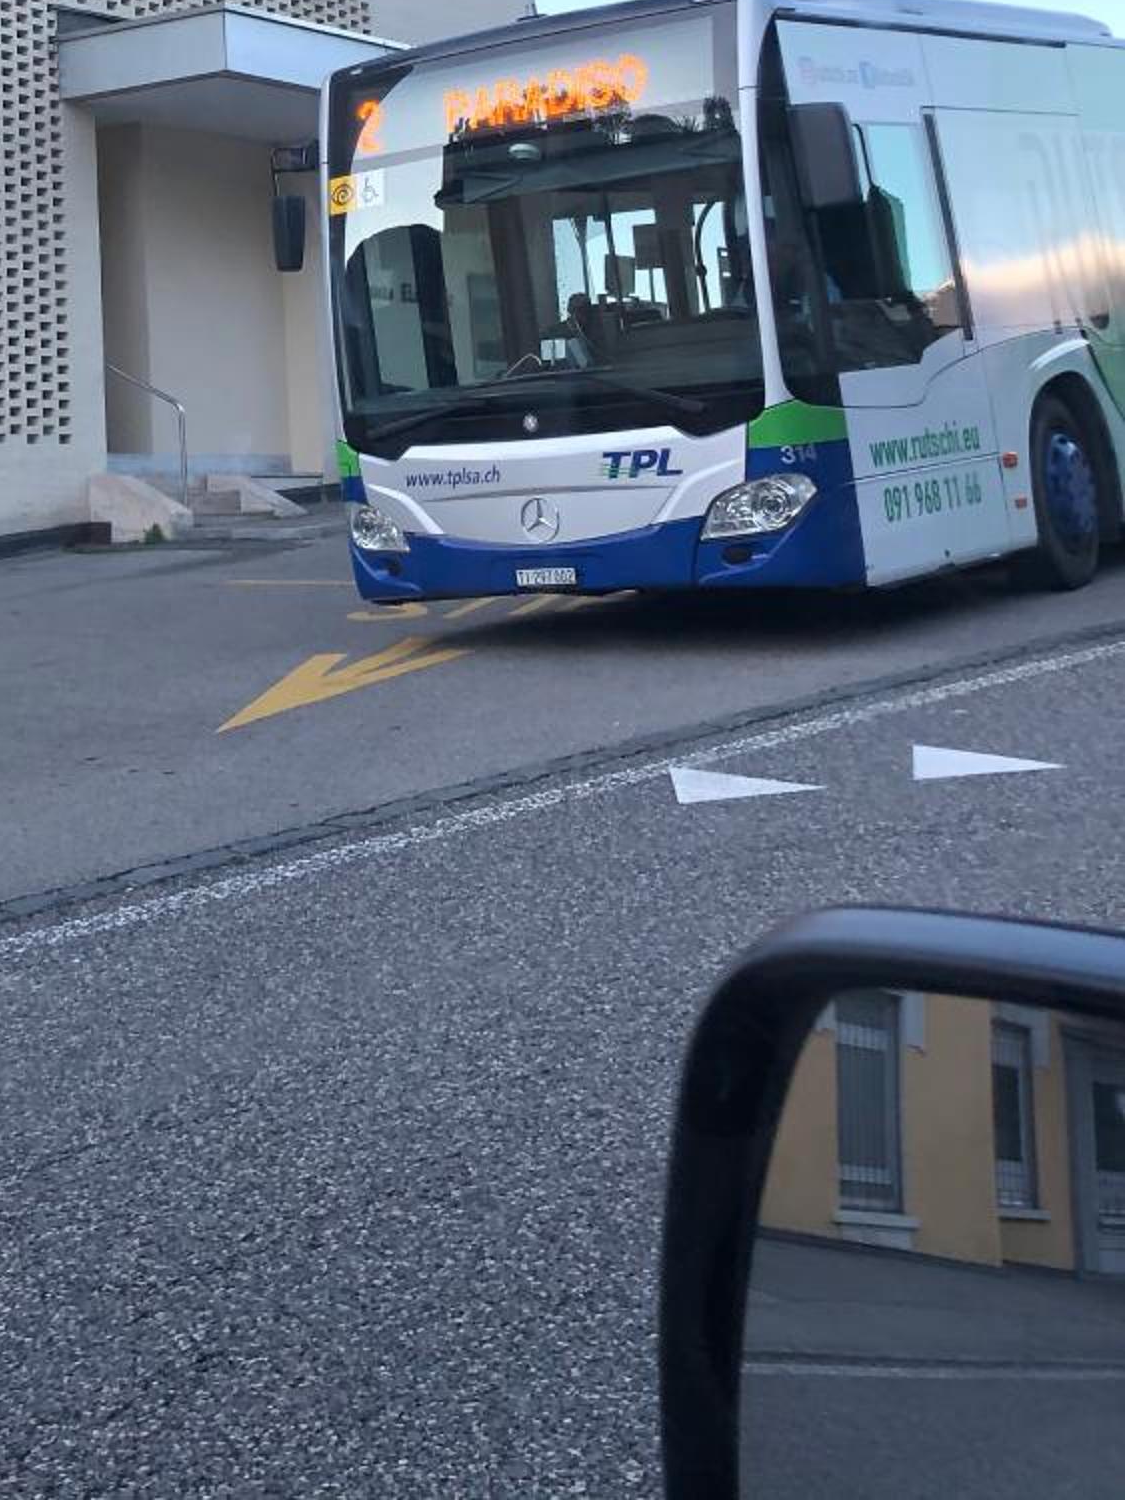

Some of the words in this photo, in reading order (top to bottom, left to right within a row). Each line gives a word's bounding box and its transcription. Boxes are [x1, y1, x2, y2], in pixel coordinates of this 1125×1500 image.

[779, 444, 818, 465] 314
[868, 420, 981, 469] www.rutschi.eu
[406, 464, 500, 489] www.tplsa.ch
[602, 448, 683, 479] TPL
[883, 485, 912, 522] 091
[914, 479, 942, 516] 968
[943, 476, 962, 510] 11
